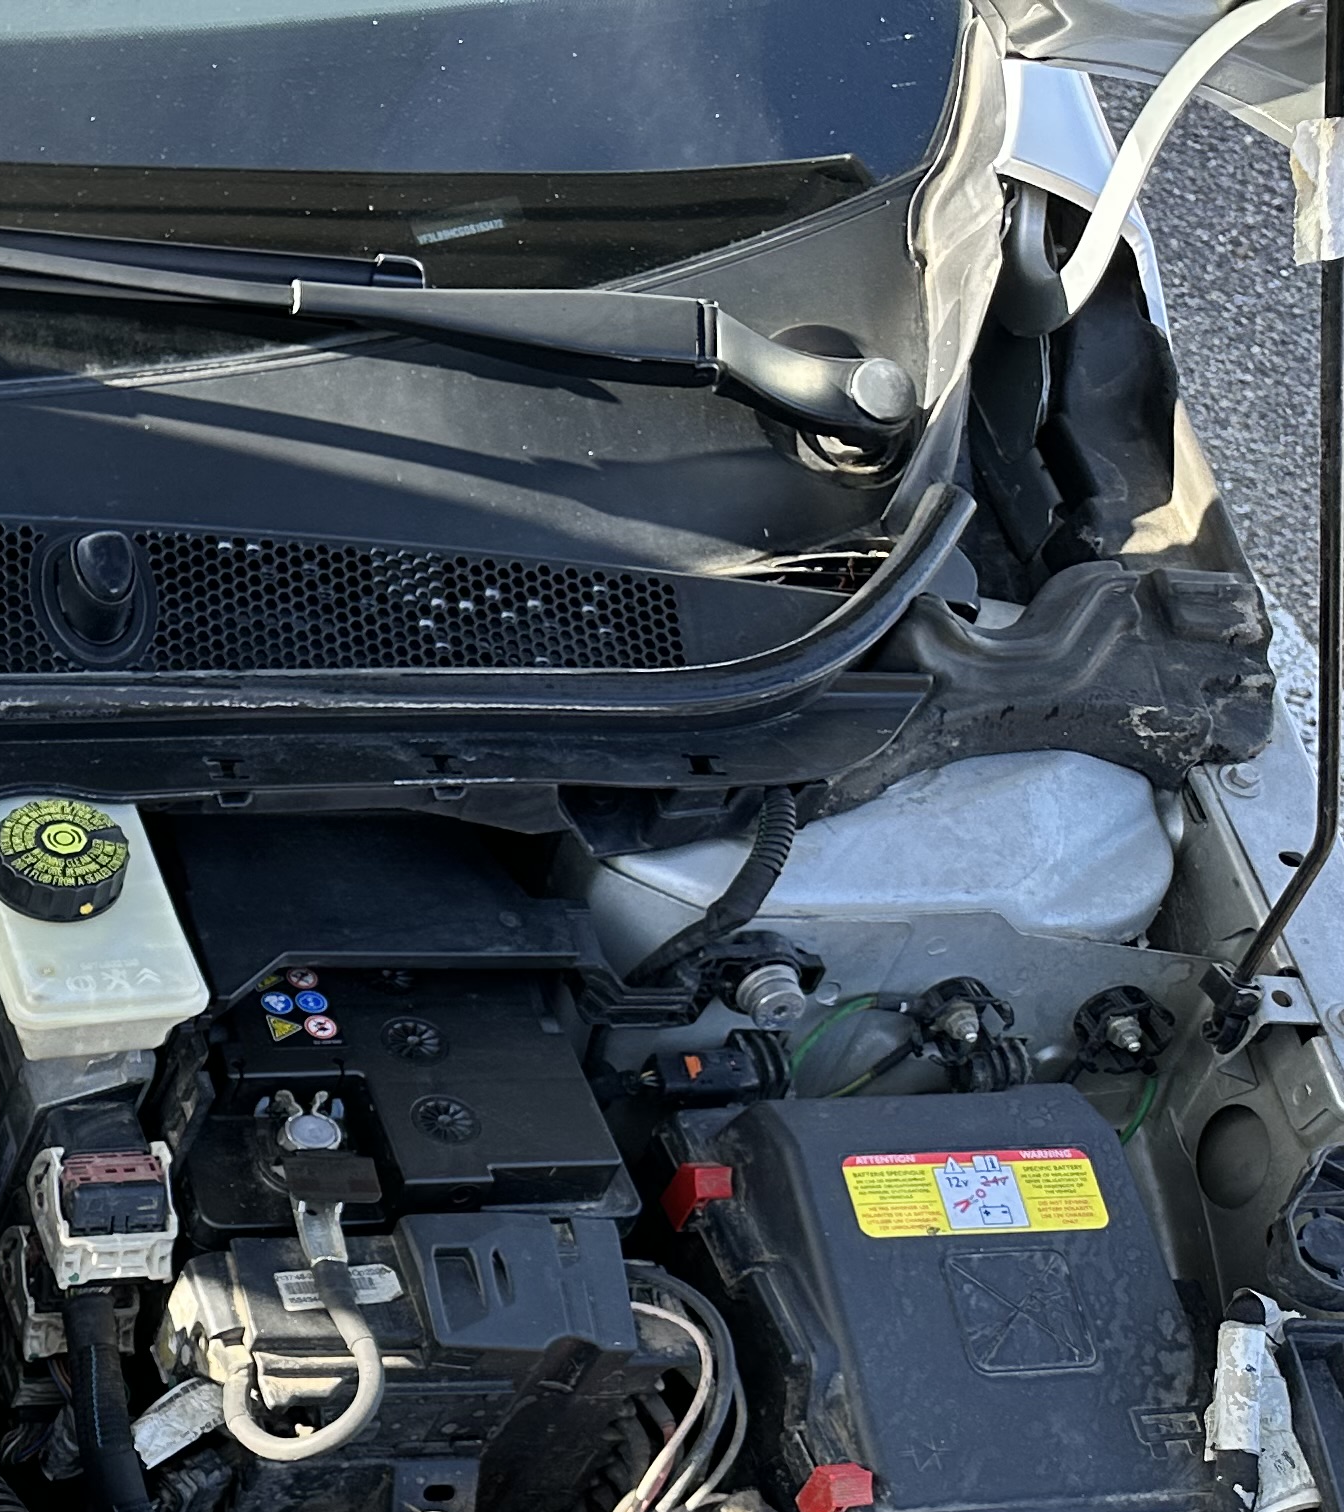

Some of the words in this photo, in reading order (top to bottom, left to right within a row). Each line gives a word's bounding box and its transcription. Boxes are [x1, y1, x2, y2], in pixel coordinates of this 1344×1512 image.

[30, 870, 52, 884] FLUID
[52, 875, 76, 886] FROM
[78, 876, 85, 886] A
[85, 867, 112, 884] SEALED
[855, 1154, 916, 1165] ATTENTION
[1018, 1149, 1072, 1159] WARNING
